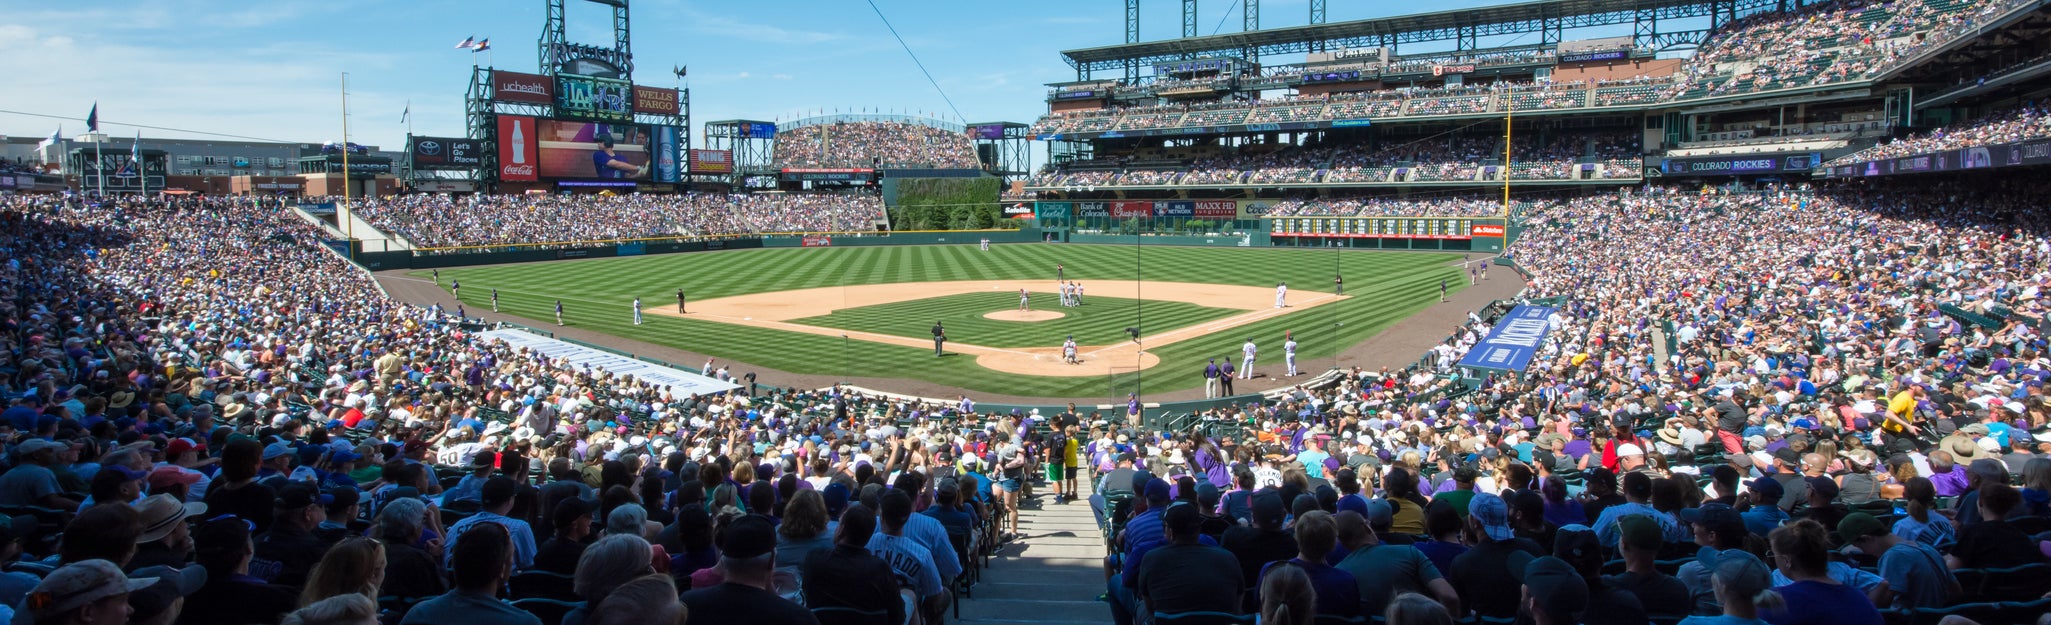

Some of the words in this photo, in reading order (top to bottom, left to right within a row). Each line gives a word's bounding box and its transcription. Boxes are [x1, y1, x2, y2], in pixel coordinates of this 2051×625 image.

[551, 43, 634, 73] ROCKIES
[503, 80, 545, 94] uchealth
[637, 89, 673, 101] WELLS
[639, 100, 673, 111] FARGO
[453, 142, 470, 150] Let's
[2024, 143, 2050, 159] COLORADO
[698, 151, 724, 161] KING
[1692, 161, 1731, 170] COLORADO
[1733, 159, 1771, 169] ROCKIES
[1195, 202, 1221, 210] MAXX
[1080, 209, 1109, 217] Colorado
